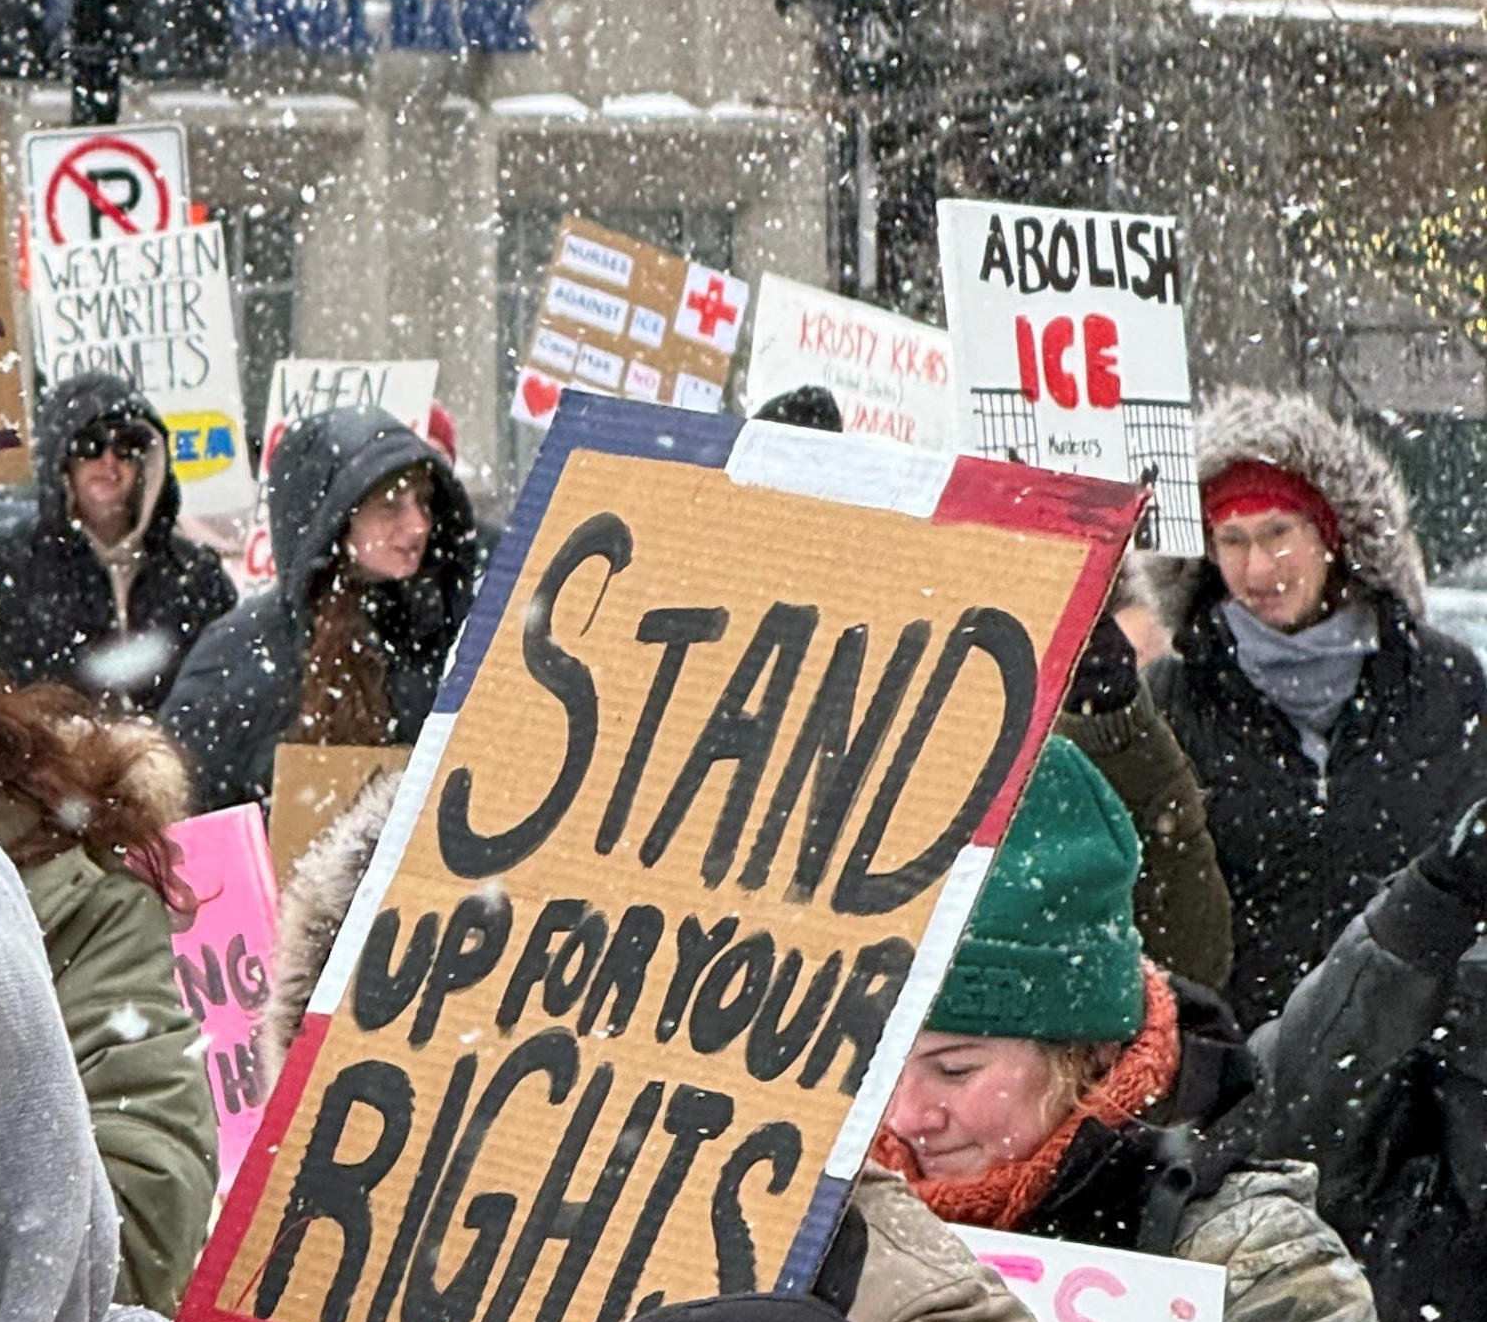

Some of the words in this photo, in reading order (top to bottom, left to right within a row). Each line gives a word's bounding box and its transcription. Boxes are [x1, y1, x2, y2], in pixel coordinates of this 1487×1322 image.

[566, 241, 628, 272] NURSES
[979, 214, 1181, 304] ABOLISH
[55, 279, 207, 345] SMARTER
[554, 285, 622, 322] AGAINST
[634, 314, 660, 334] ICE
[799, 310, 878, 367] KRUSTY
[280, 366, 392, 416] WHEN
[1016, 313, 1121, 410] ICE
[436, 511, 1038, 917] STAND
[353, 892, 512, 1050] UP
[497, 898, 666, 1039] FOR
[658, 915, 915, 1096] YOUR
